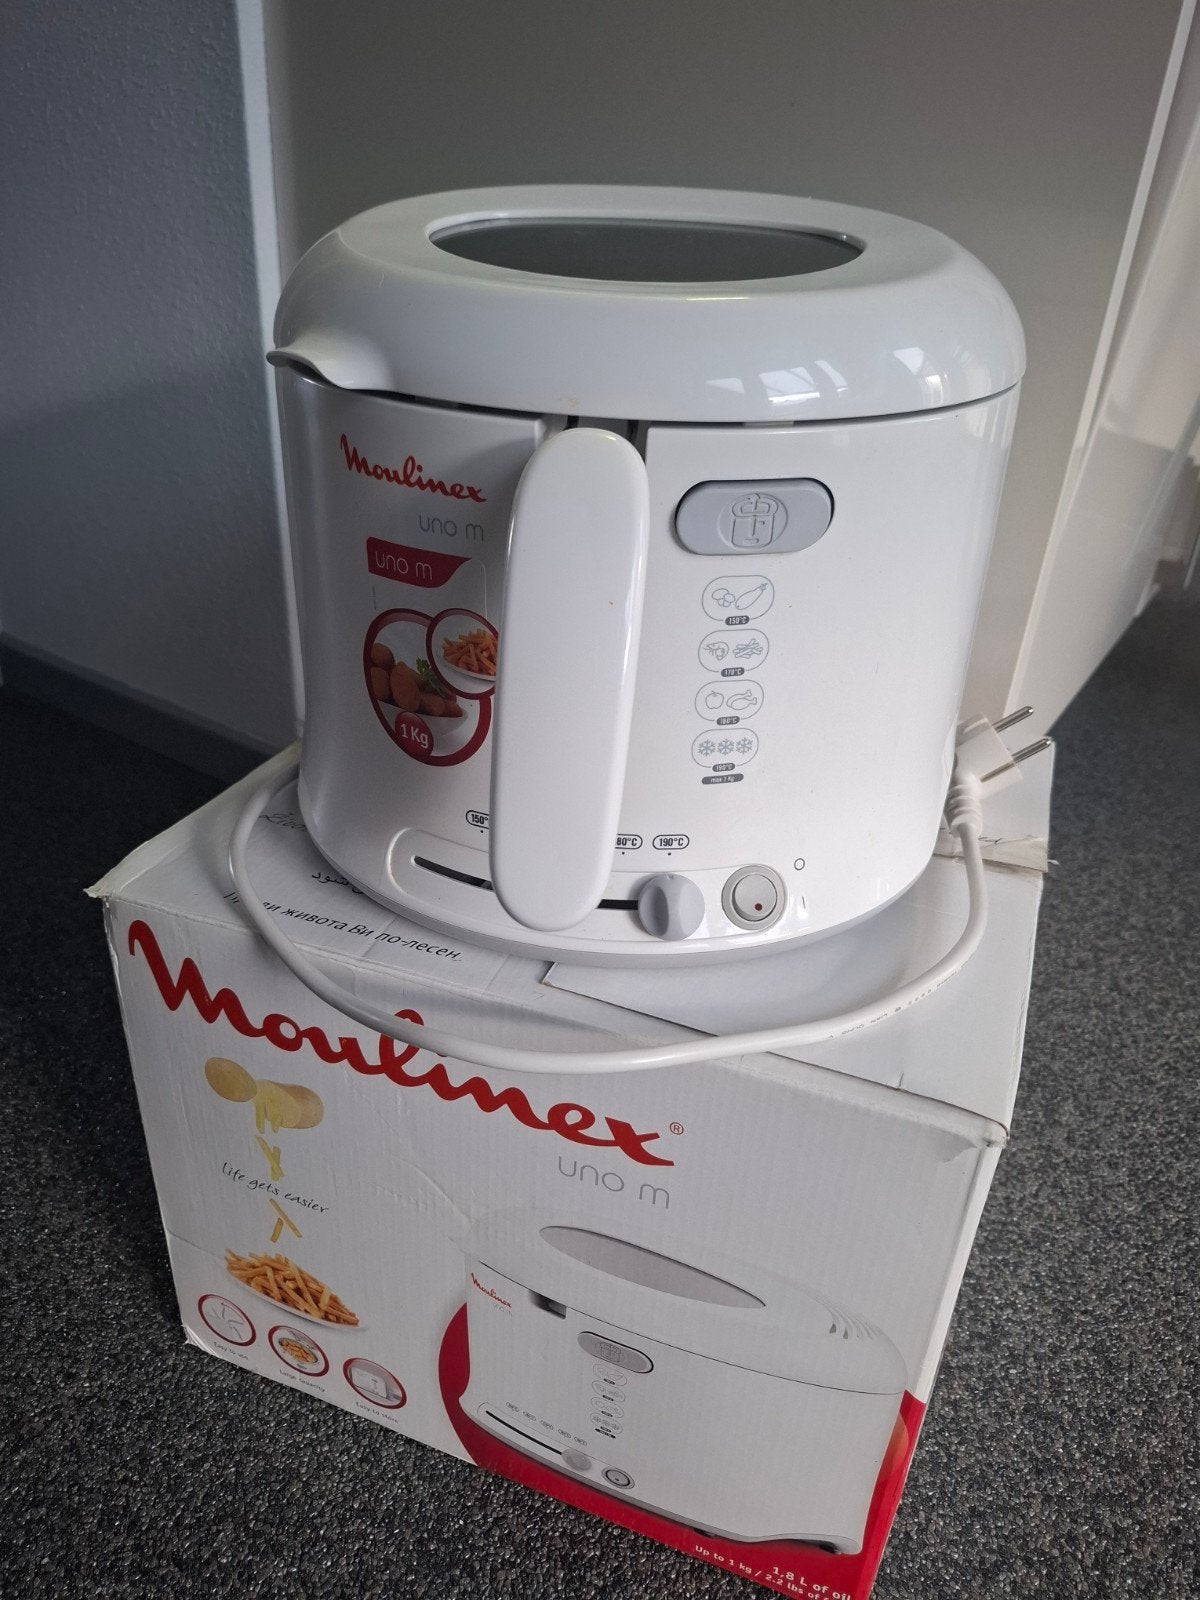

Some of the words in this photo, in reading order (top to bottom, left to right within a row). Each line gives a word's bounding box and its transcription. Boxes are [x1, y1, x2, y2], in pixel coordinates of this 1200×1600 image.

[340, 433, 487, 503] Moulinex
[419, 515, 457, 537] uno
[465, 523, 484, 541] m
[375, 551, 409, 574] uno
[415, 562, 433, 580] m
[411, 726, 429, 749] Kg
[471, 813, 488, 824] 150°
[616, 837, 638, 847] 80°C
[659, 837, 684, 847] 190°C
[281, 908, 348, 930] живота
[347, 924, 374, 936] Ви
[129, 919, 675, 1167] Moulinex
[247, 1179, 280, 1196] gets
[284, 1192, 329, 1213] easier
[558, 1155, 625, 1192] uno
[639, 1183, 669, 1209] m
[695, 1545, 710, 1556] Up
[713, 1553, 725, 1562] to
[739, 1562, 752, 1574] kg
[765, 1573, 784, 1586] 2.2
[787, 1582, 804, 1594] lbs
[807, 1592, 821, 1600] of
[800, 1576, 808, 1587] L
[812, 1584, 829, 1594] of
